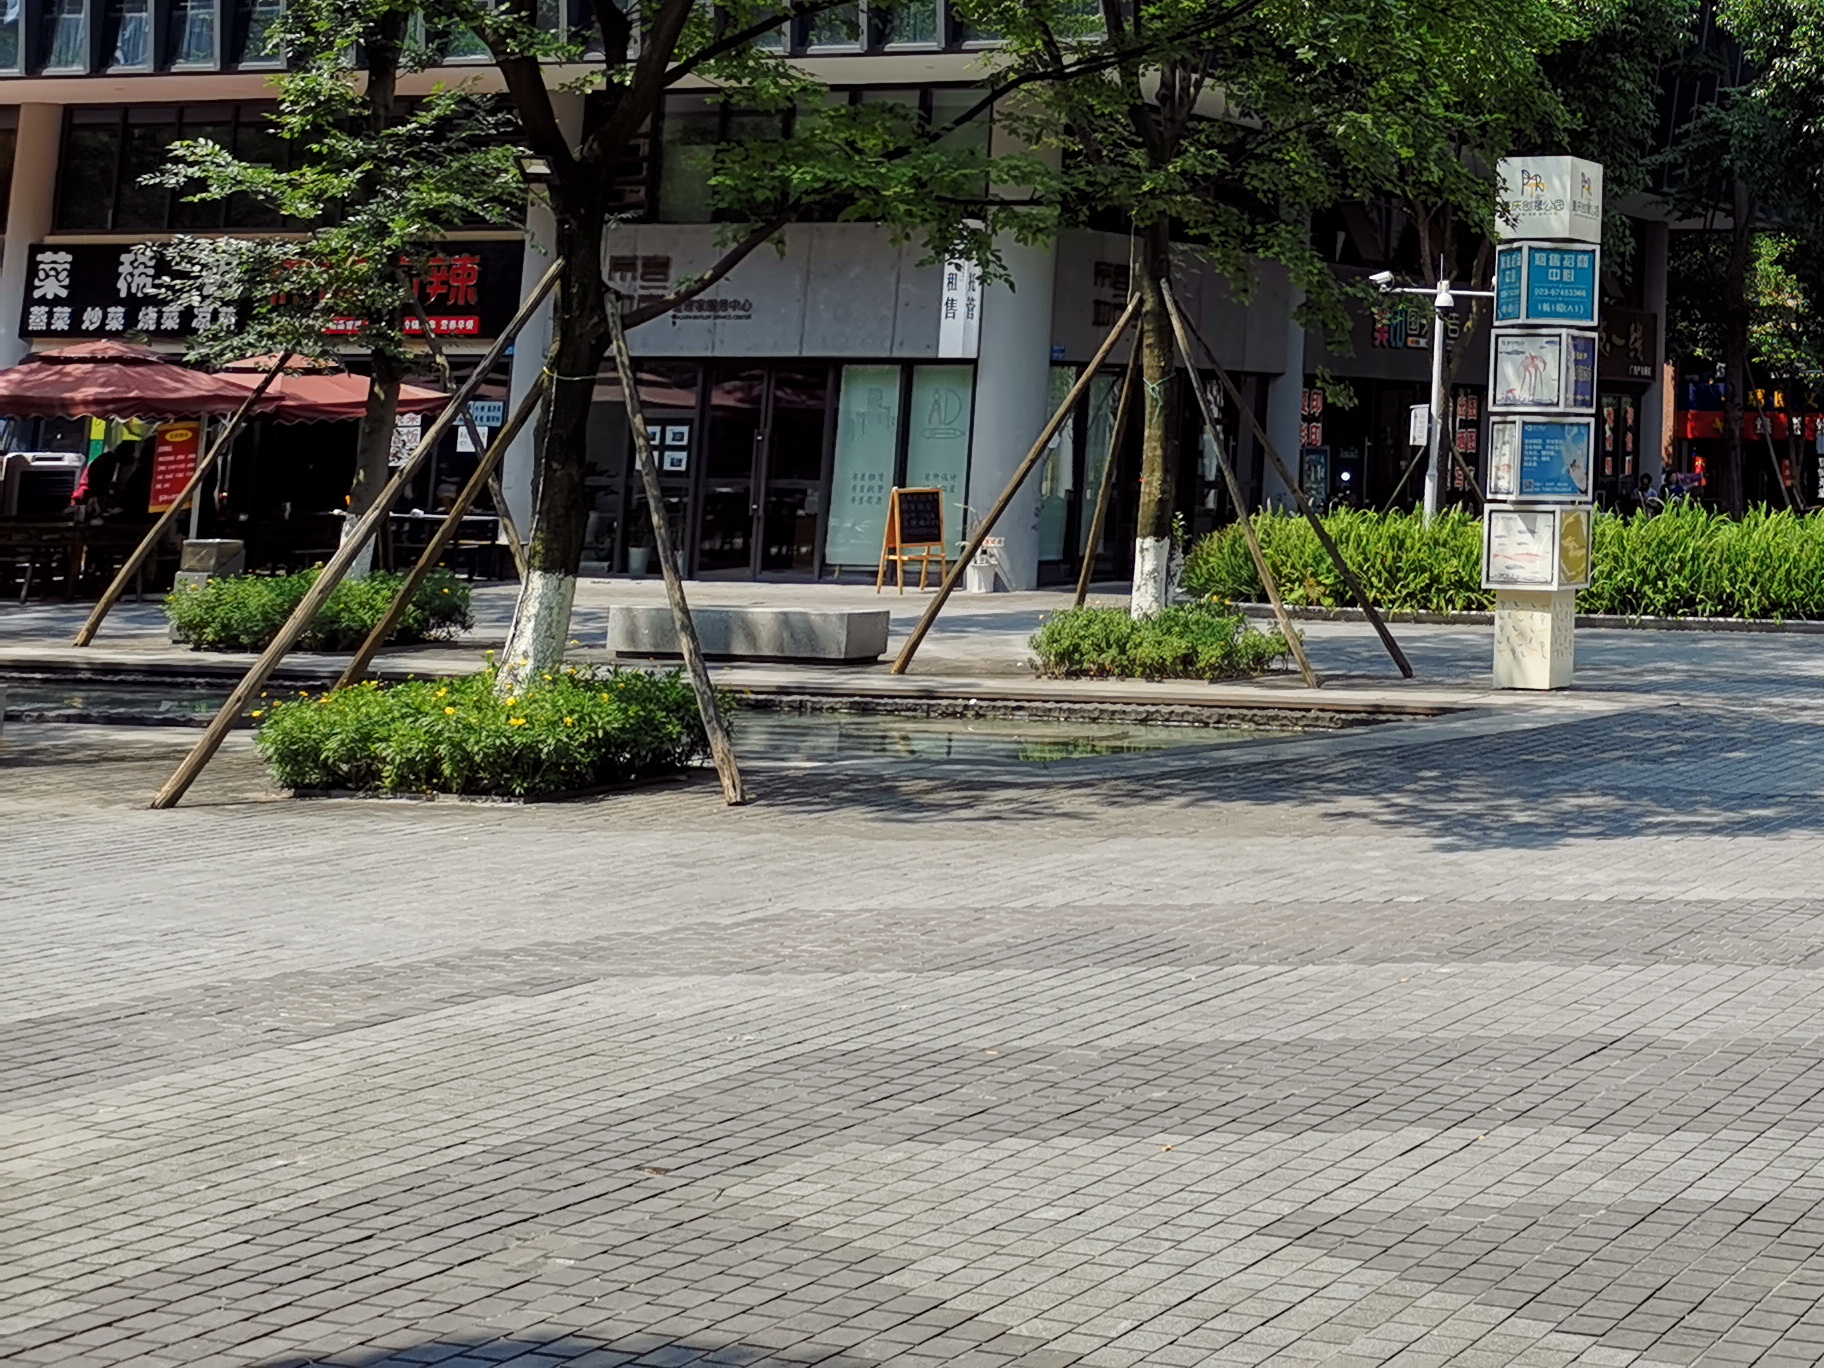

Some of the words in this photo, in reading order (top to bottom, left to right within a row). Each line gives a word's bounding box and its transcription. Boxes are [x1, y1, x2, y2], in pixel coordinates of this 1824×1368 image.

[1548, 269, 1574, 282] 中心
[28, 306, 72, 331] 蒸菜
[81, 306, 126, 331] 炒菜
[137, 306, 181, 331] 烧菜
